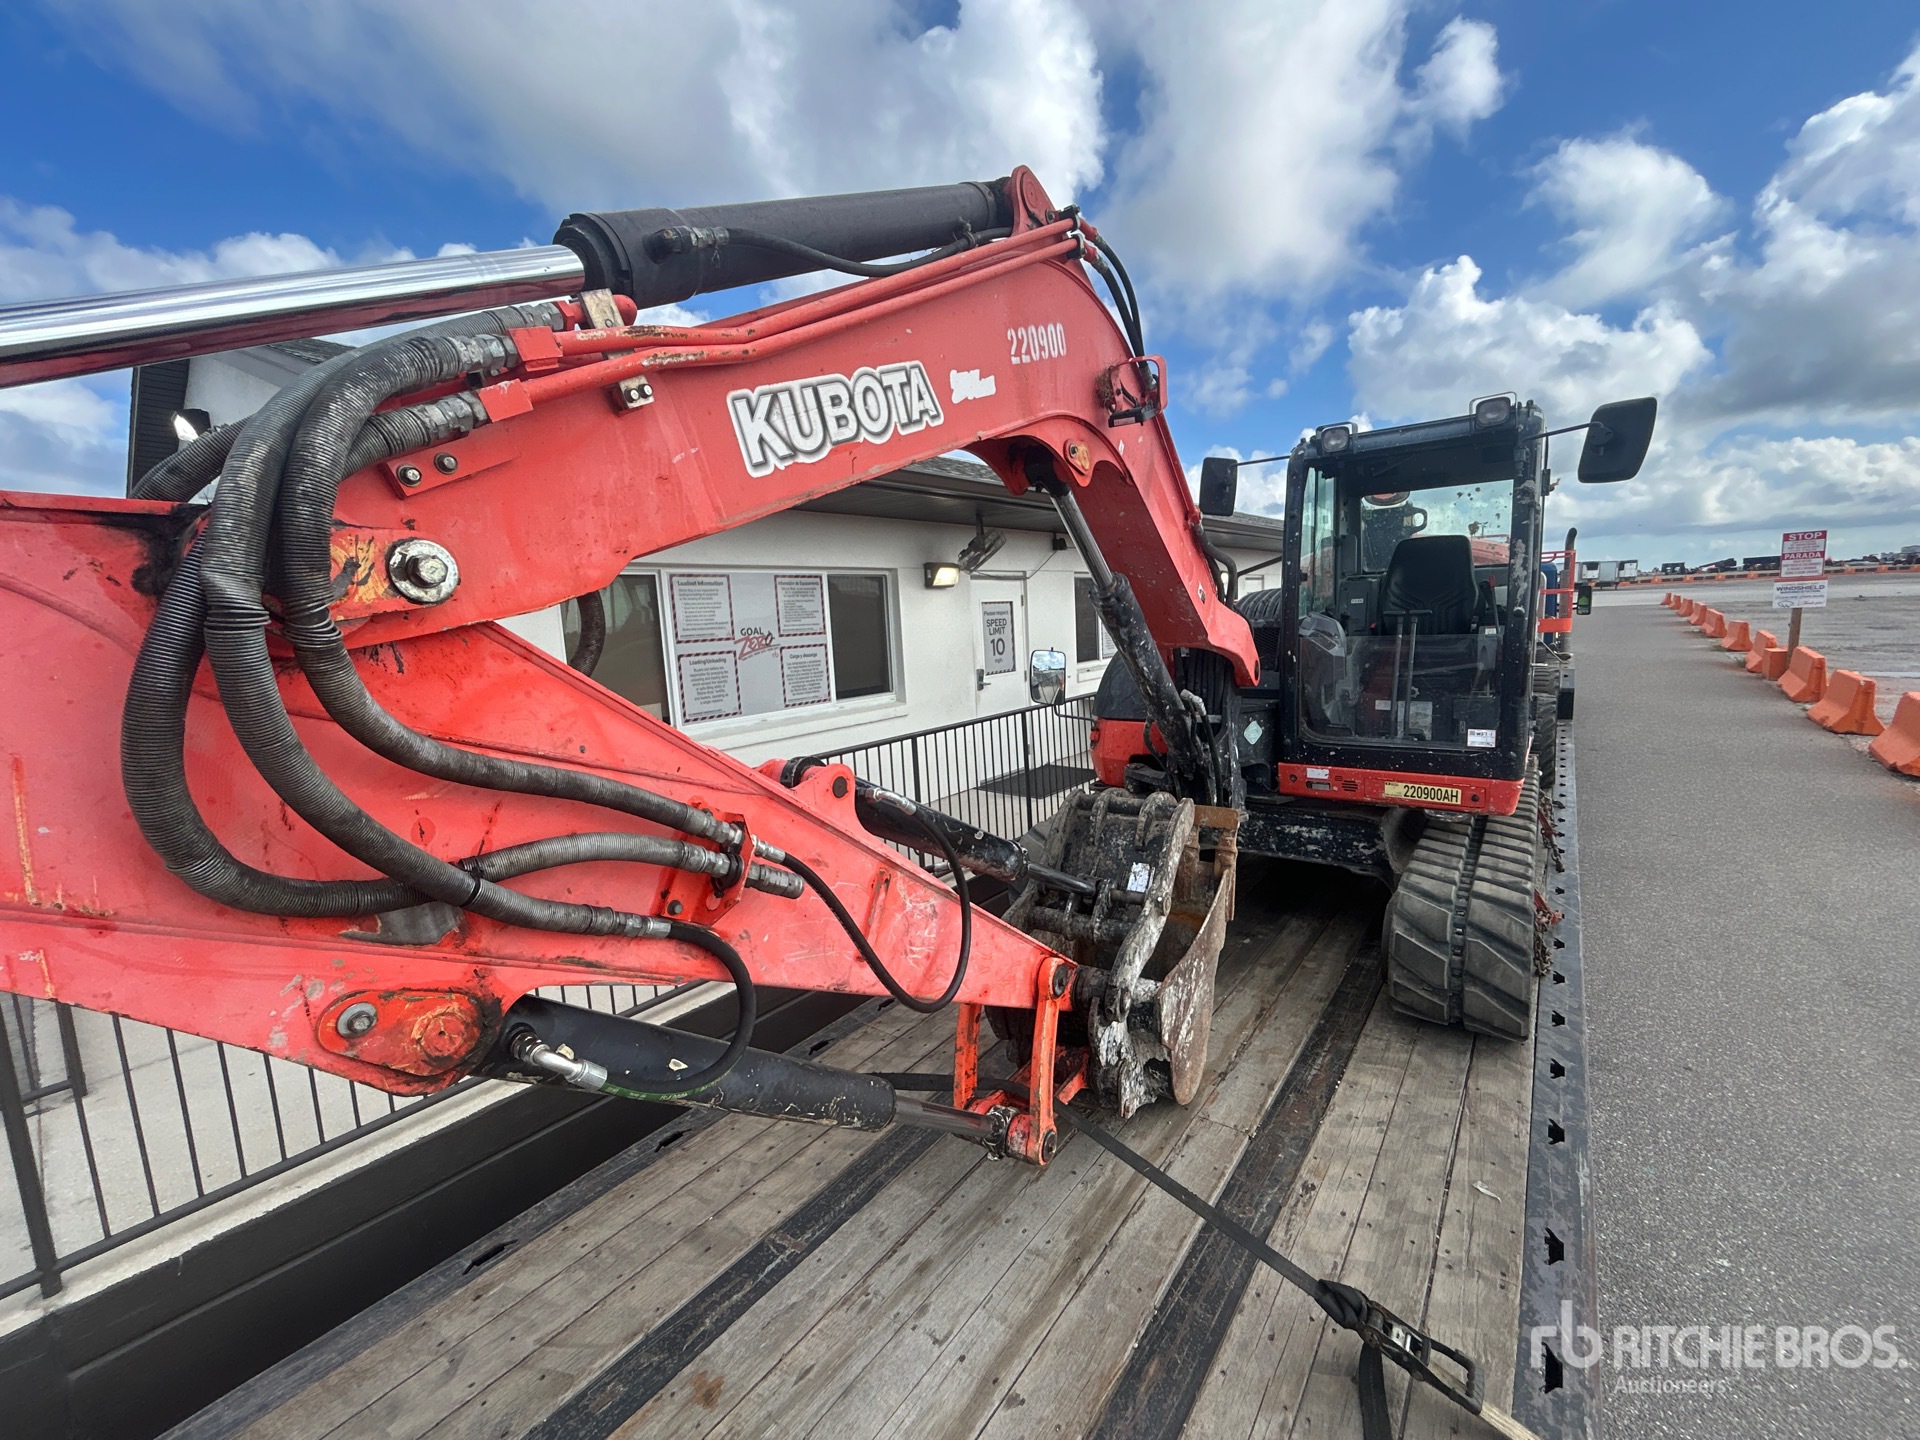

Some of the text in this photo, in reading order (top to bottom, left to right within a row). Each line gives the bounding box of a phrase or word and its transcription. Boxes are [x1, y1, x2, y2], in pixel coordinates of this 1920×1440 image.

[1007, 322, 1067, 366] 220900
[730, 362, 942, 468] KUBOTA
[1788, 532, 1822, 540] STOP
[1784, 551, 1821, 560] PARADA
[986, 618, 1007, 627] SPEED
[740, 626, 764, 636] GOAL
[989, 627, 1005, 635] LIMIT
[734, 630, 775, 660] ZERO
[991, 638, 1005, 656] 10
[1403, 784, 1459, 803] 220900AH
